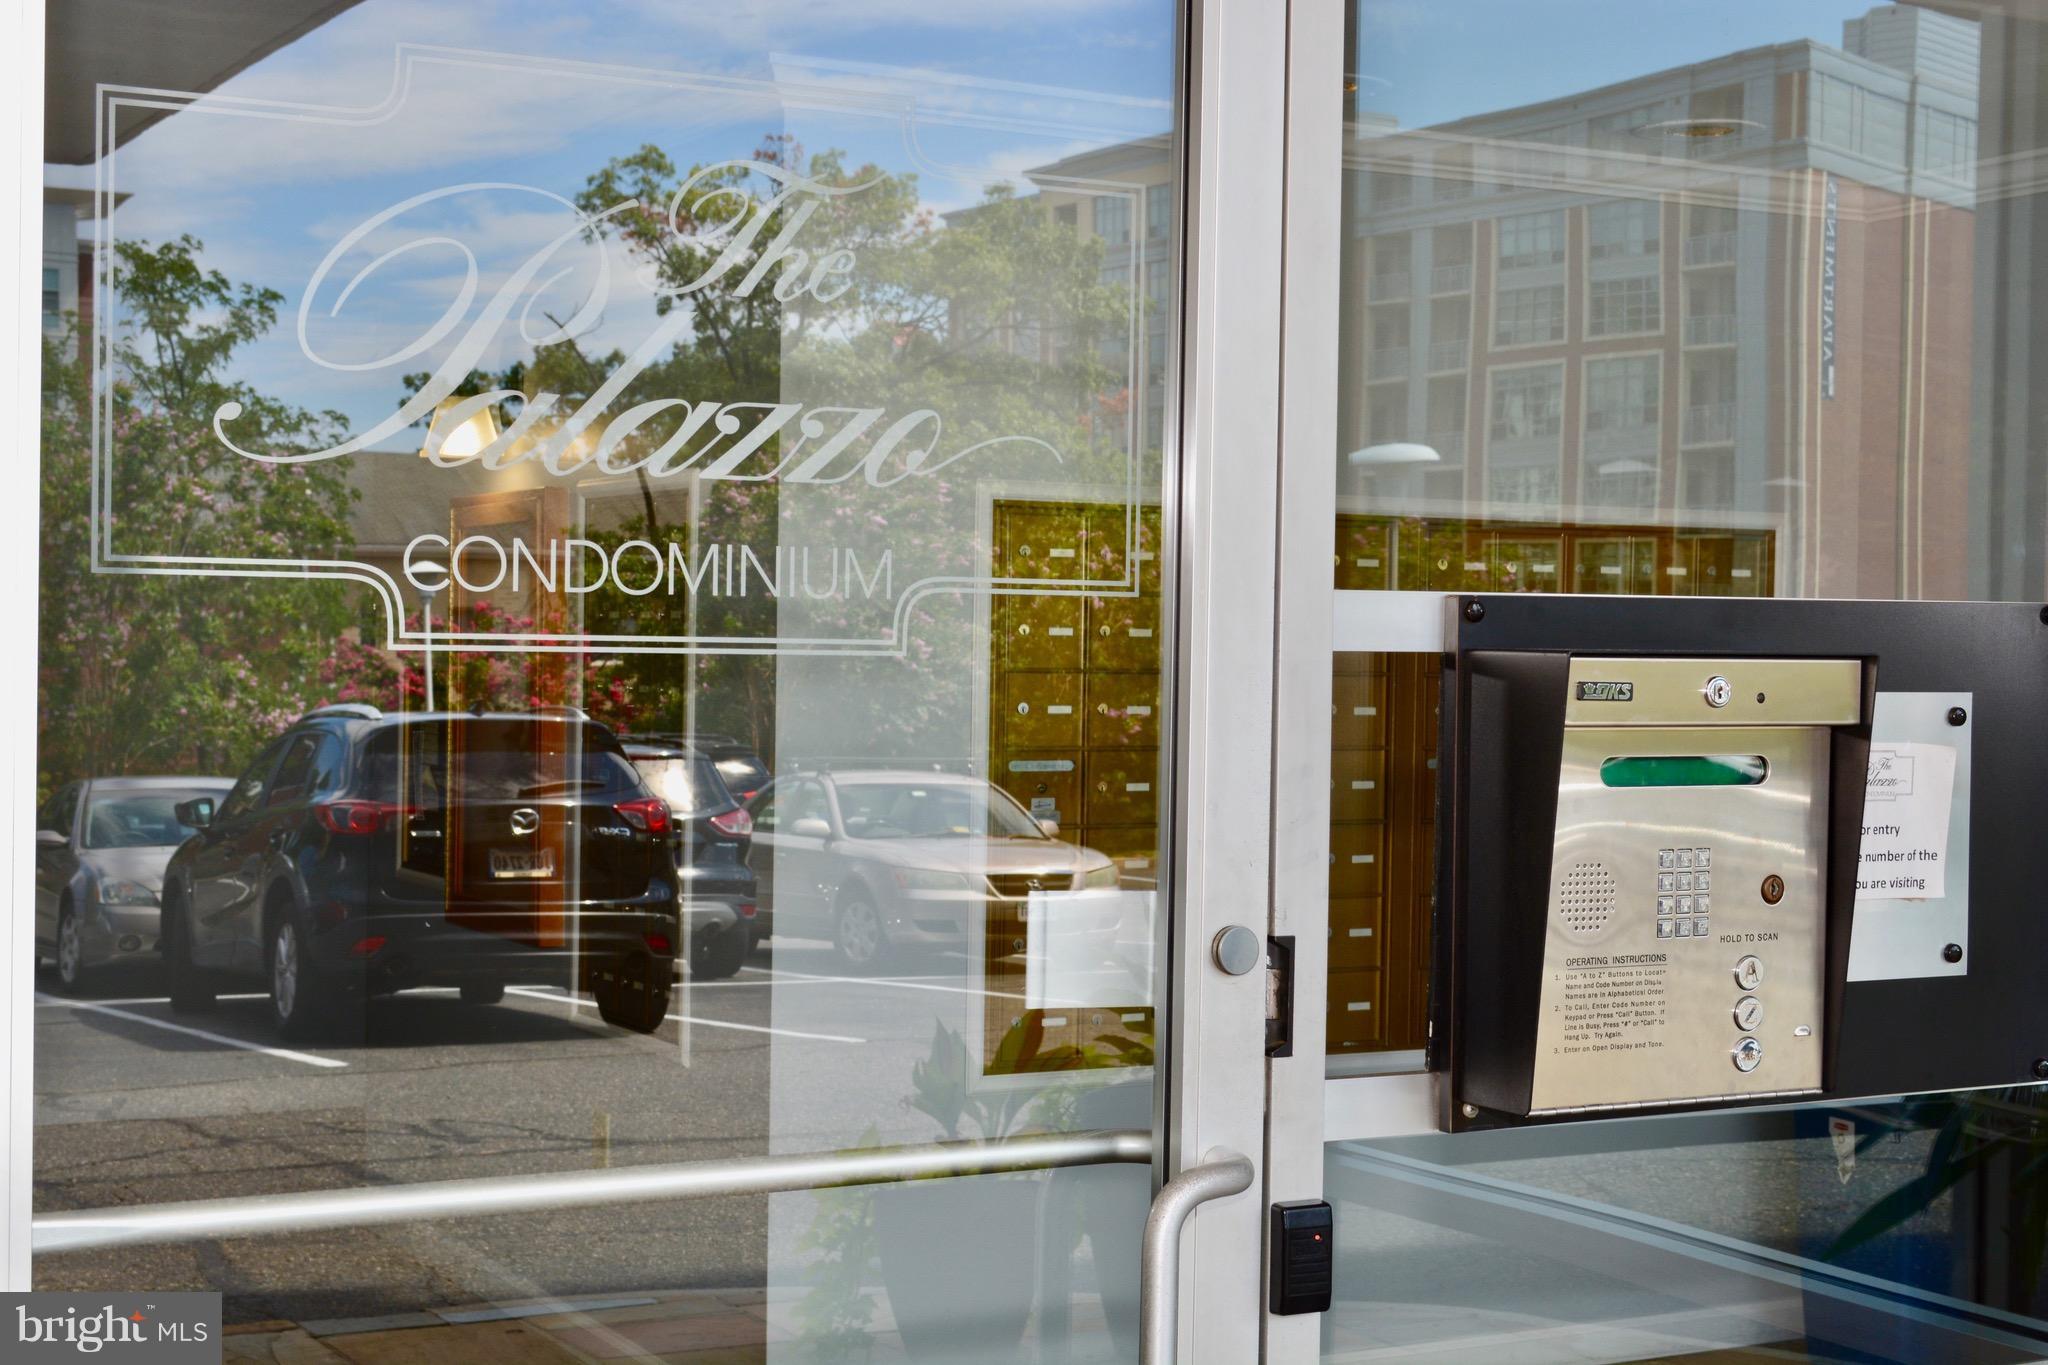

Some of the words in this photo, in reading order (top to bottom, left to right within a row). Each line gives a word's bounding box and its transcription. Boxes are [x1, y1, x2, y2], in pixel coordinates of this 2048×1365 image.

[637, 159, 884, 303] The
[213, 182, 1064, 488] Palazzo
[402, 533, 893, 601] CONDOMINIUM
[1873, 825, 1901, 837] entry
[1865, 850, 1904, 862] number
[1907, 850, 1917, 861] of
[1919, 849, 1938, 861] the
[1870, 879, 1887, 889] are
[1889, 876, 1926, 890] visiting
[1720, 934, 1742, 943] HOLD
[1745, 933, 1755, 942] TO
[1757, 932, 1778, 942] SCAN
[1566, 956, 1608, 967] OPERATING
[1612, 953, 1667, 964] INSTRUCTIONS
[1608, 970, 1633, 978] Buttons
[1596, 981, 1610, 989] Code
[1612, 980, 1634, 988] Number
[1608, 988, 1646, 998] Alphabetical
[1592, 1002, 1610, 1010] Enter
[1612, 1001, 1628, 1009] Code
[1631, 1000, 1655, 1008] Number
[1565, 1013, 1587, 1022] Keypad
[1565, 1023, 1577, 1031] Line
[1603, 1021, 1620, 1029] Press
[1564, 1033, 1580, 1041] Hang
[1564, 1046, 1581, 1054] Enter
[1592, 1044, 1608, 1052] Open
[1610, 1042, 1633, 1051] Display
